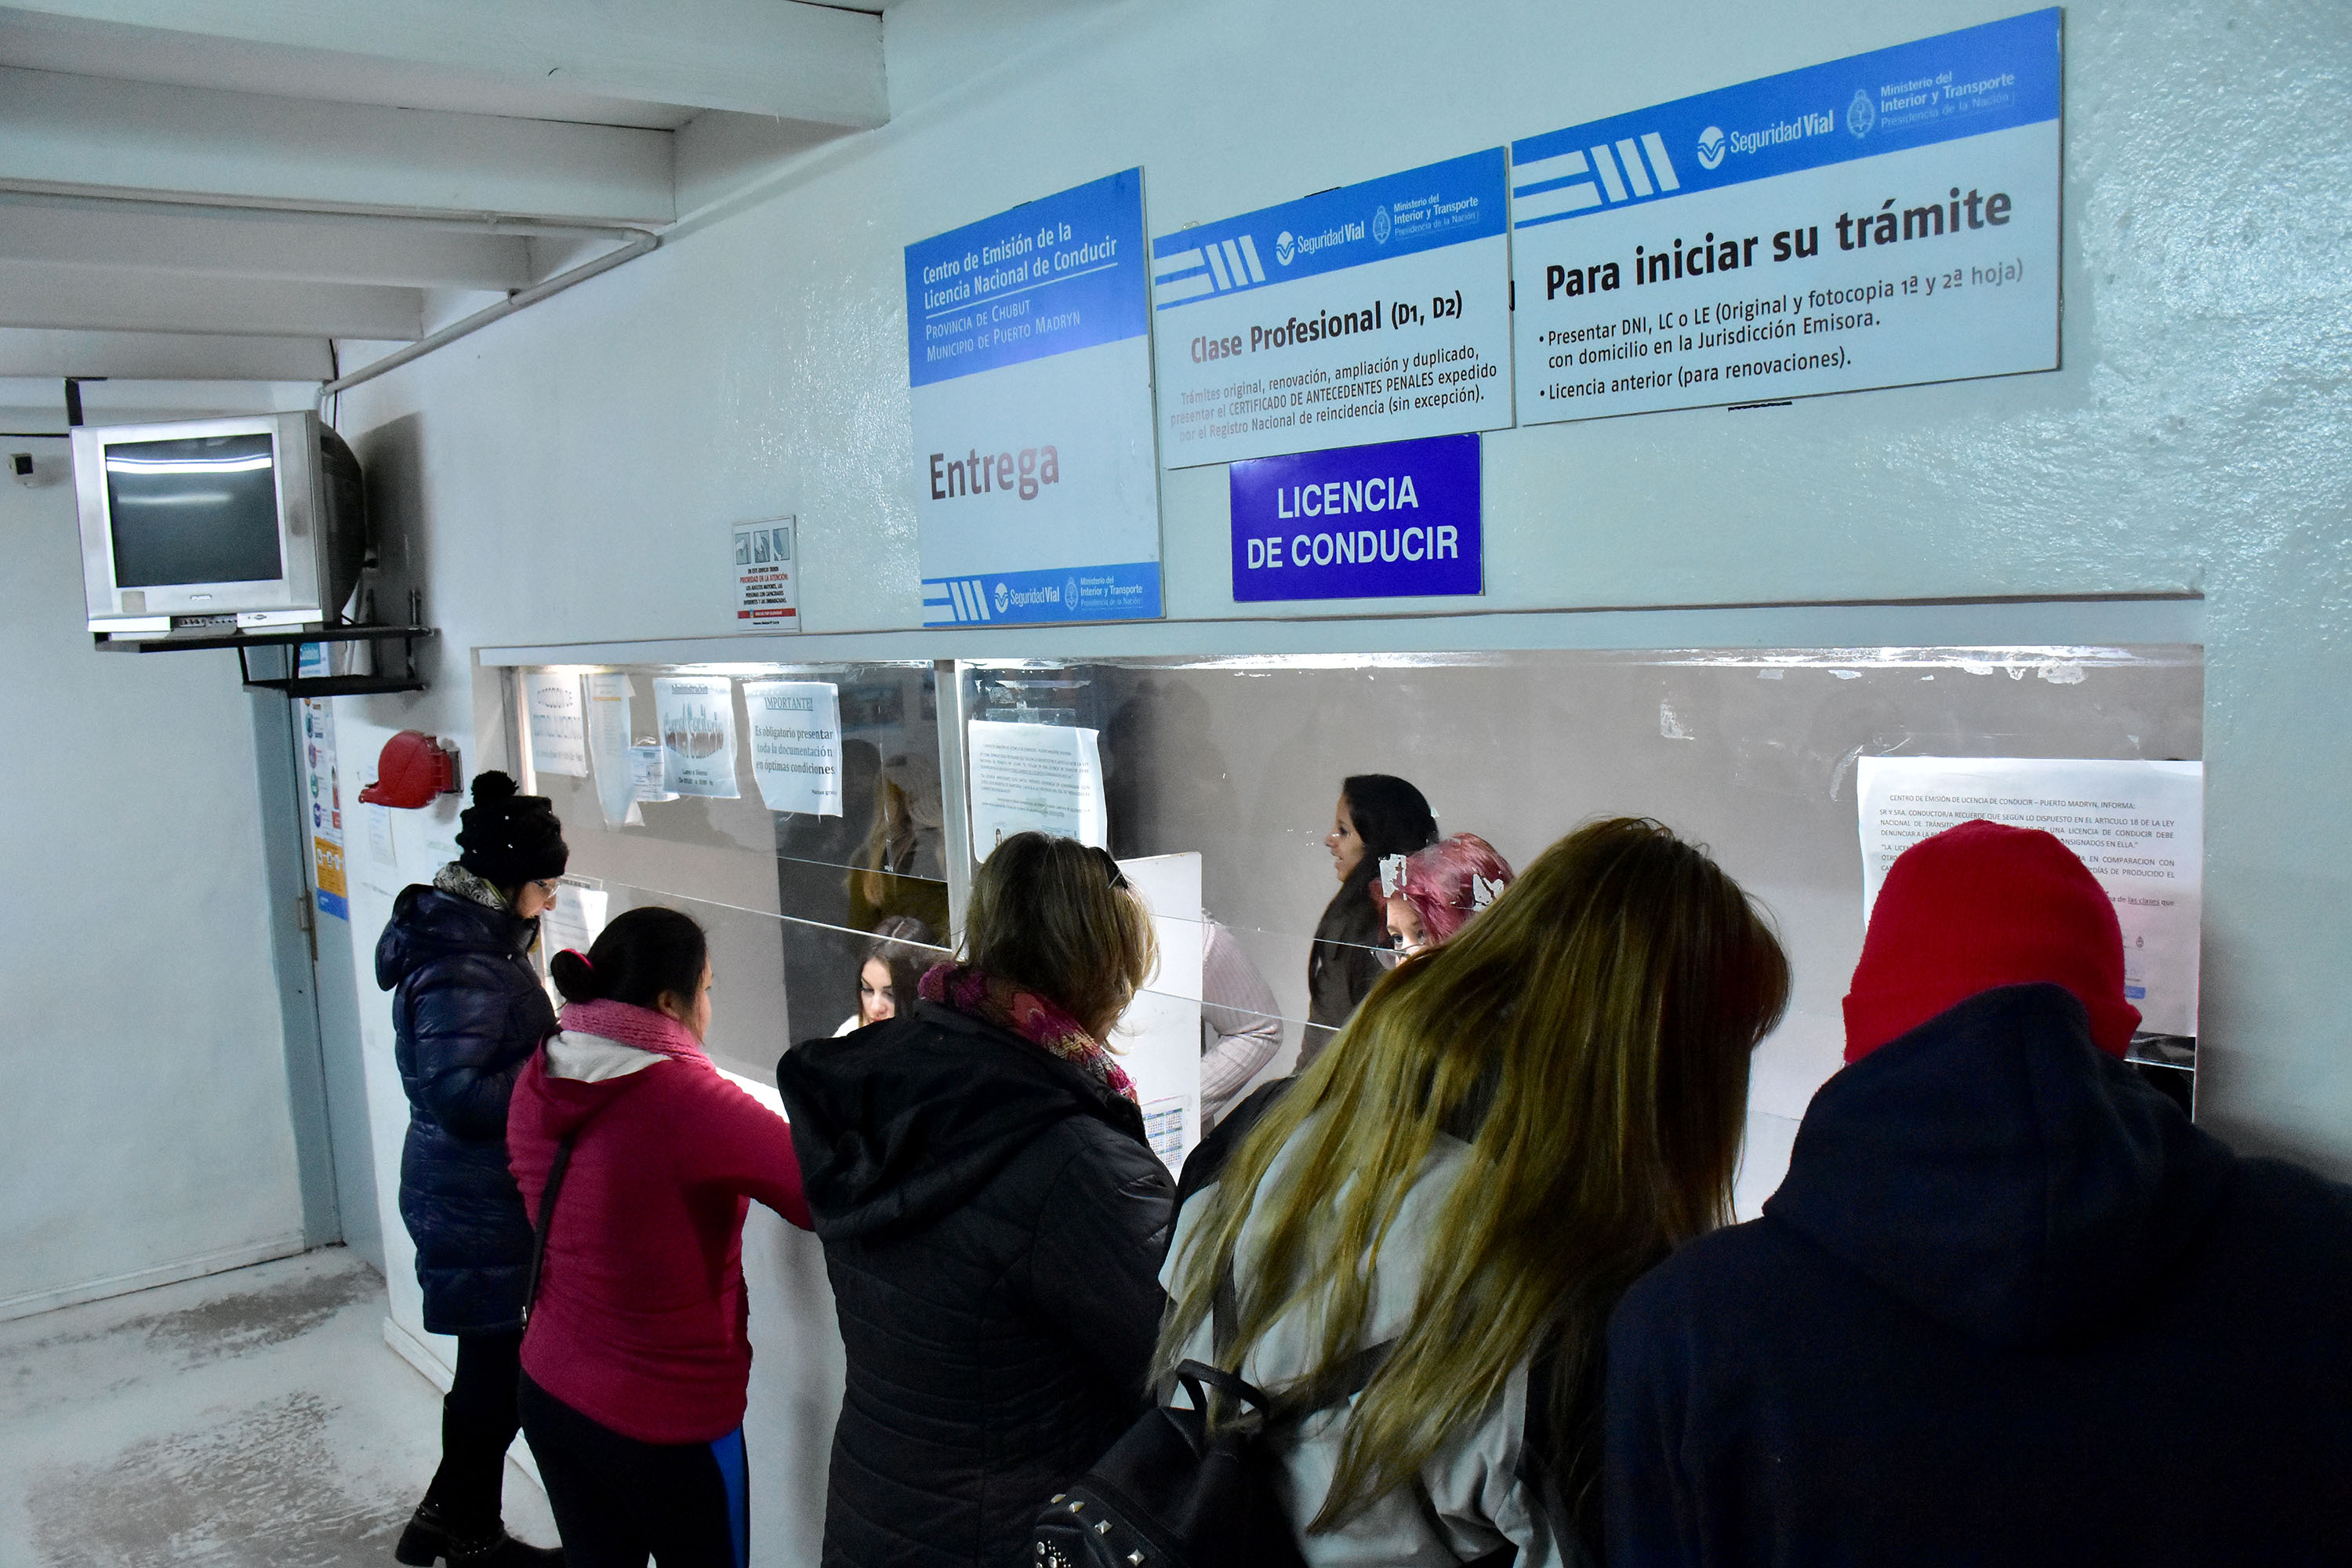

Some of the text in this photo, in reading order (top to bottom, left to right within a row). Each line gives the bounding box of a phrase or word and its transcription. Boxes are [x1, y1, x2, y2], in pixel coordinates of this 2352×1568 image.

[1882, 71, 1951, 97] Ministerio del
[1882, 74, 2015, 113] Interior y Transporte
[1394, 194, 1439, 212] Ministerio del
[1394, 197, 1479, 224] Interior y Transporte
[1395, 223, 1431, 236] Presidencia
[1434, 219, 1442, 228] de
[1452, 211, 1475, 223] Nación
[924, 223, 1071, 285] Centro de Emisión de la
[1546, 187, 2011, 299] Para iniciar su trámite
[924, 235, 1117, 310] Licencia Nacional de Conducir
[926, 300, 1030, 340] PROVINCIA DE CHUBUT
[1548, 321, 1616, 346] Presentar
[1623, 317, 1652, 336] DNI,
[1659, 313, 1673, 330] LC
[1679, 315, 1687, 327] o
[1695, 307, 1710, 325] LE
[1716, 296, 1786, 321] (Original
[1794, 296, 1802, 314] y
[1809, 280, 1894, 309] fotocopia
[1926, 277, 1936, 296] y
[1972, 258, 2023, 285] hoja)
[927, 312, 1080, 362] MUNICIPIO DE PUERTO MADRYN
[1192, 290, 1463, 363] Clase Profesional (D1, D2)
[1548, 312, 1880, 368] con domicilio en la Jurisdicción Emisora.
[1171, 363, 1497, 427] presentar el CERTIFICADO DE ANTECEDENTES PENALES expedido
[1181, 345, 1479, 405] Trámites original, renovación, ampliación y duplicado,
[1549, 346, 1852, 400] Licencia anterior (para renovaciones).
[1180, 384, 1483, 443] por el Registro Nacional de reincidencia (sin excepción).
[930, 445, 1058, 500] Entrega
[1278, 475, 1418, 519] LICENCIA
[1248, 525, 1458, 569] DE CONDUCIR
[1080, 587, 1102, 596] Interior
[1109, 585, 1142, 595] Transporte
[755, 726, 833, 741] Es obligatorio presentar
[757, 743, 833, 757] toda la documentación
[757, 760, 835, 775] en óptimas condiciones
[2036, 815, 2072, 823] DISPUESTO
